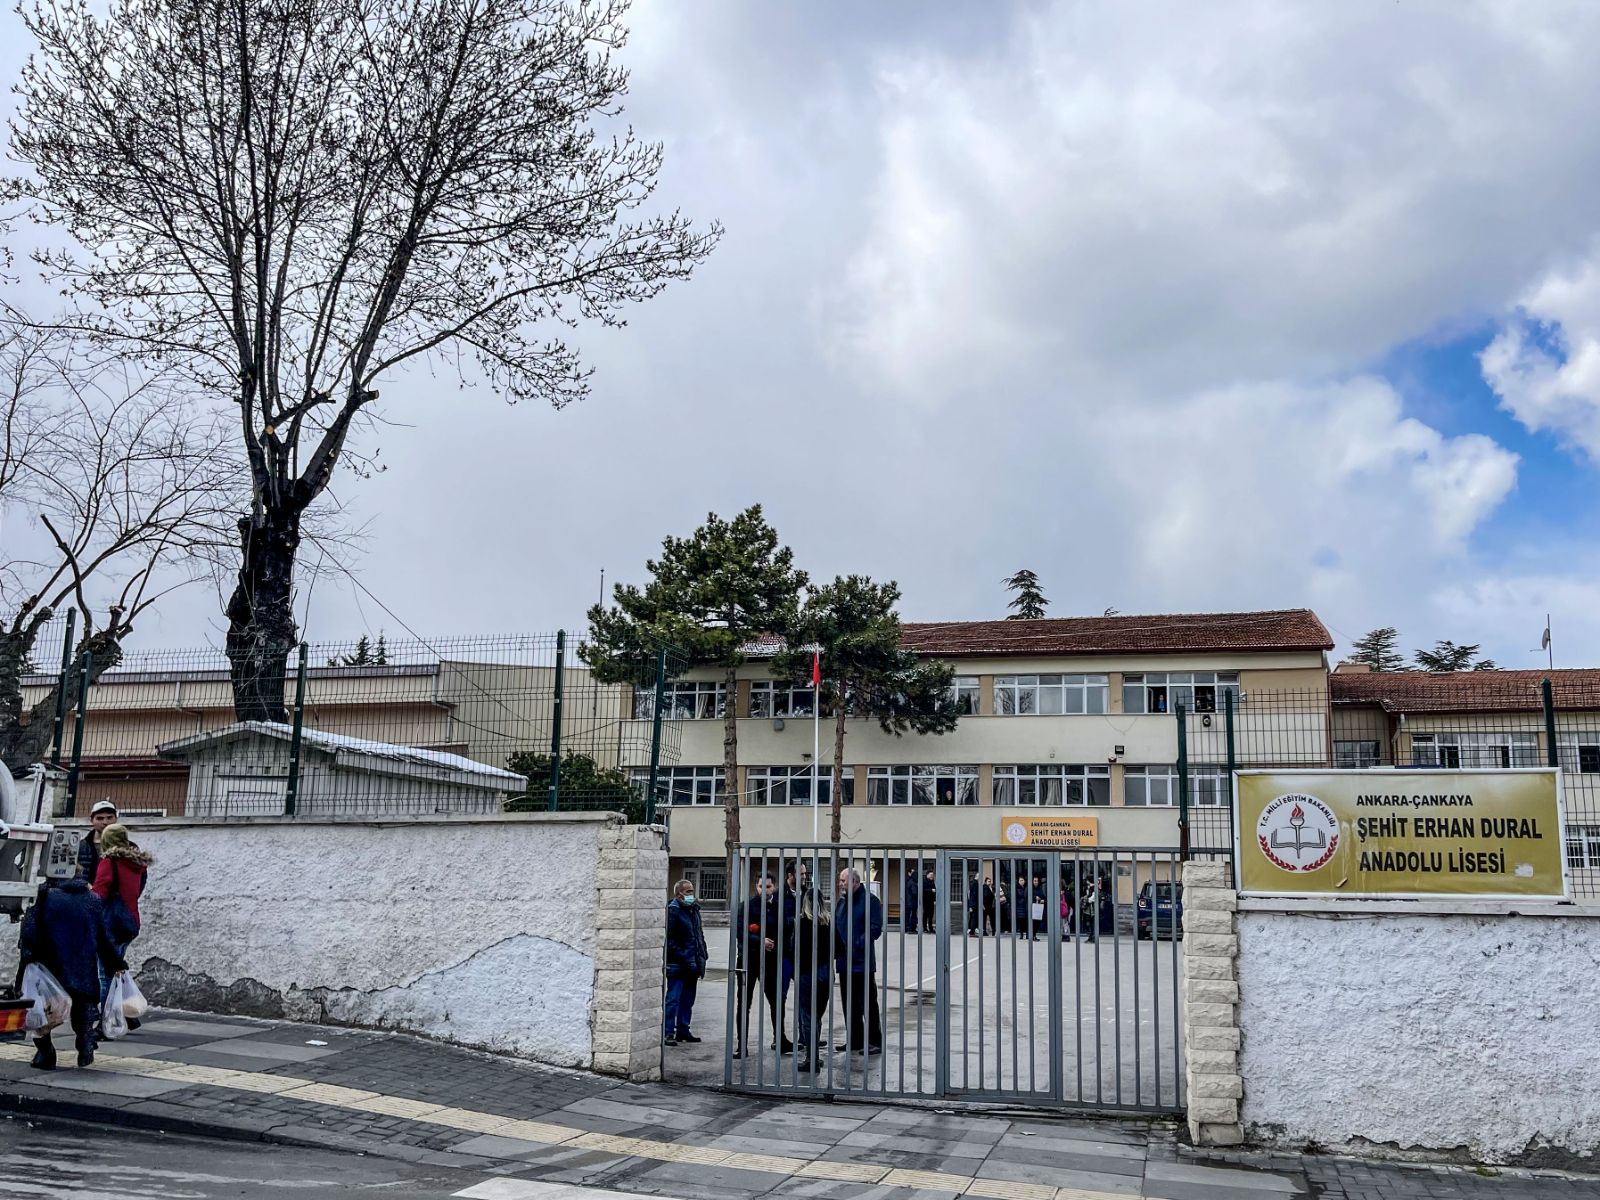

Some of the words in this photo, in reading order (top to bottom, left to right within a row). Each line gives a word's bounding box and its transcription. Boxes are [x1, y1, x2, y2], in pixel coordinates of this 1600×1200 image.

[1266, 798, 1283, 815] MİLLİ
[1283, 795, 1307, 804] EĞİTİM
[1308, 798, 1337, 827] BAKANLIĞI
[1356, 795, 1474, 810] ANKARA-ÇANKAYA
[1051, 829, 1071, 837] ERHAN
[1073, 829, 1094, 837] DURAL
[1357, 813, 1408, 842] ŞEHİT
[1414, 817, 1475, 838] ERHAN
[1481, 818, 1542, 839] DURAL
[1359, 851, 1442, 872] ANADOLU
[1449, 847, 1505, 873] LİSESİ
